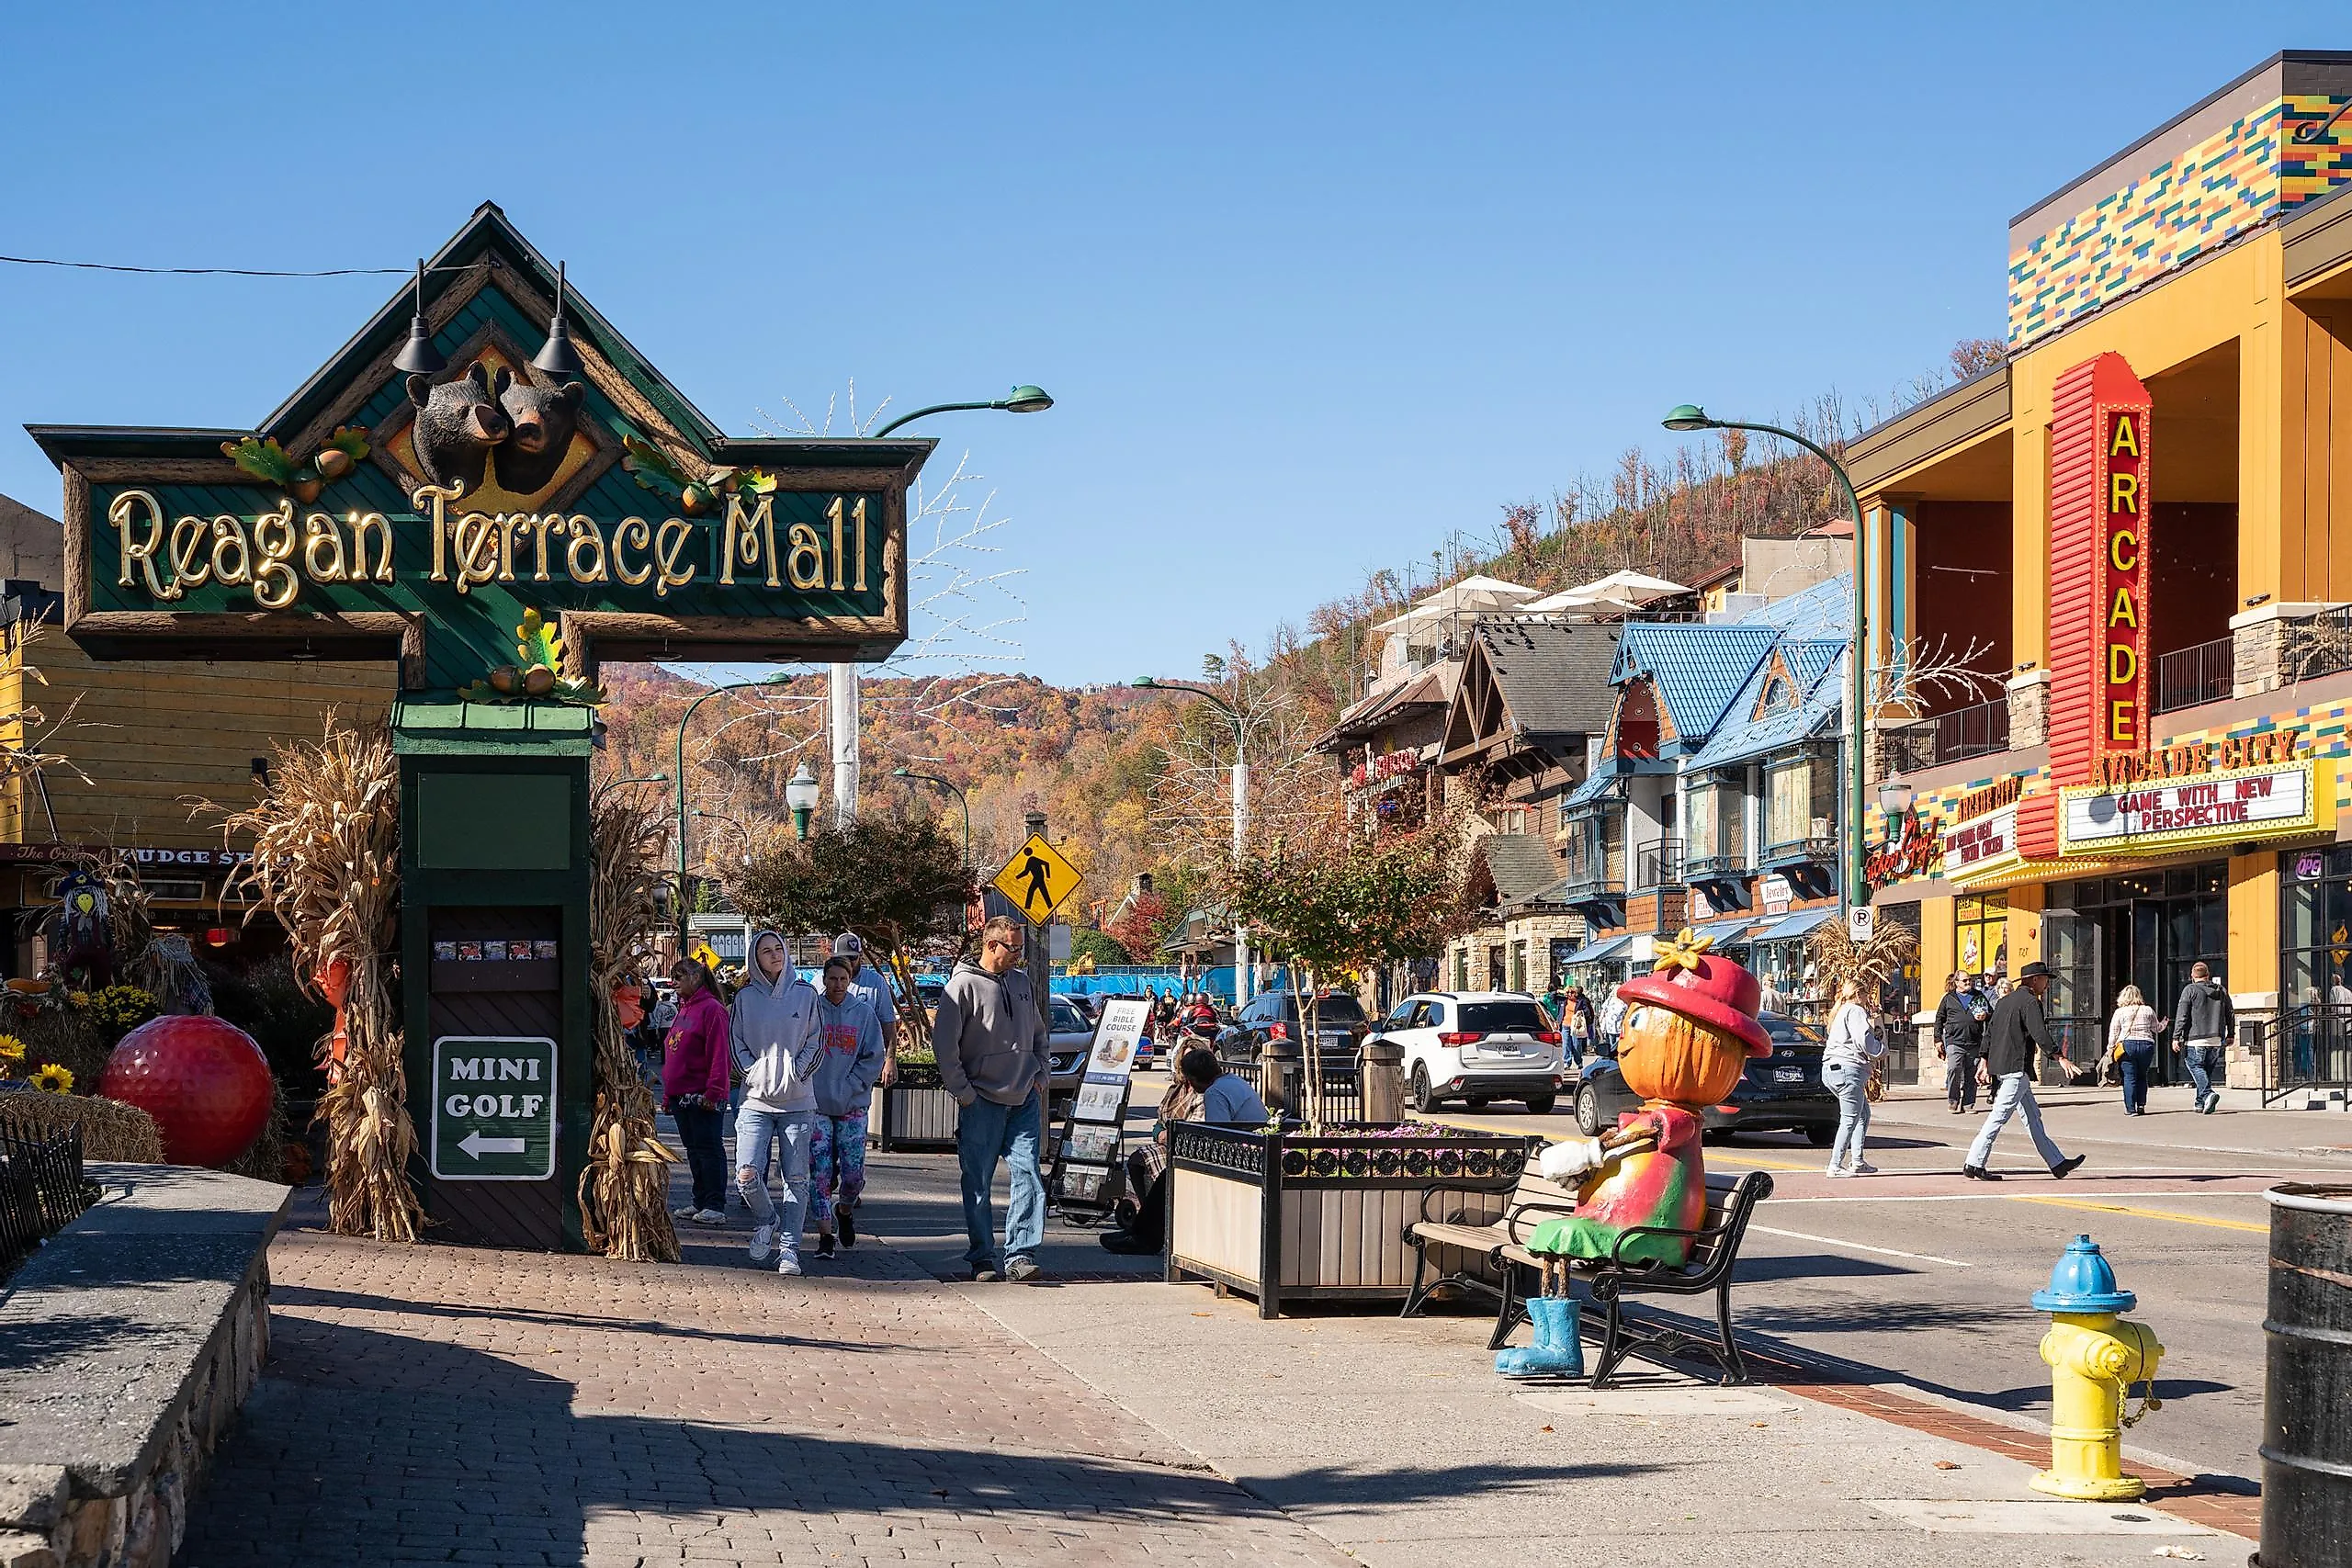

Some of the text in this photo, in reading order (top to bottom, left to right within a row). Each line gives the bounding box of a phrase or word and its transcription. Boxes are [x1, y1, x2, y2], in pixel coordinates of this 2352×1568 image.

[107, 479, 868, 609] Reagan Terrace Mall
[2109, 415, 2140, 741] ARCADE
[2090, 728, 2300, 787] ARCADE CITY
[1958, 775, 2023, 825] ARCADE CITY
[2117, 776, 2273, 814] GAME WITH NEW
[2142, 800, 2248, 830] PERSPECTIVE
[17, 846, 44, 860] The
[1116, 1007, 1136, 1015] FREE
[1105, 1023, 1137, 1032] COURSE
[450, 1057, 541, 1081] MINI
[445, 1094, 544, 1118] GOLF
